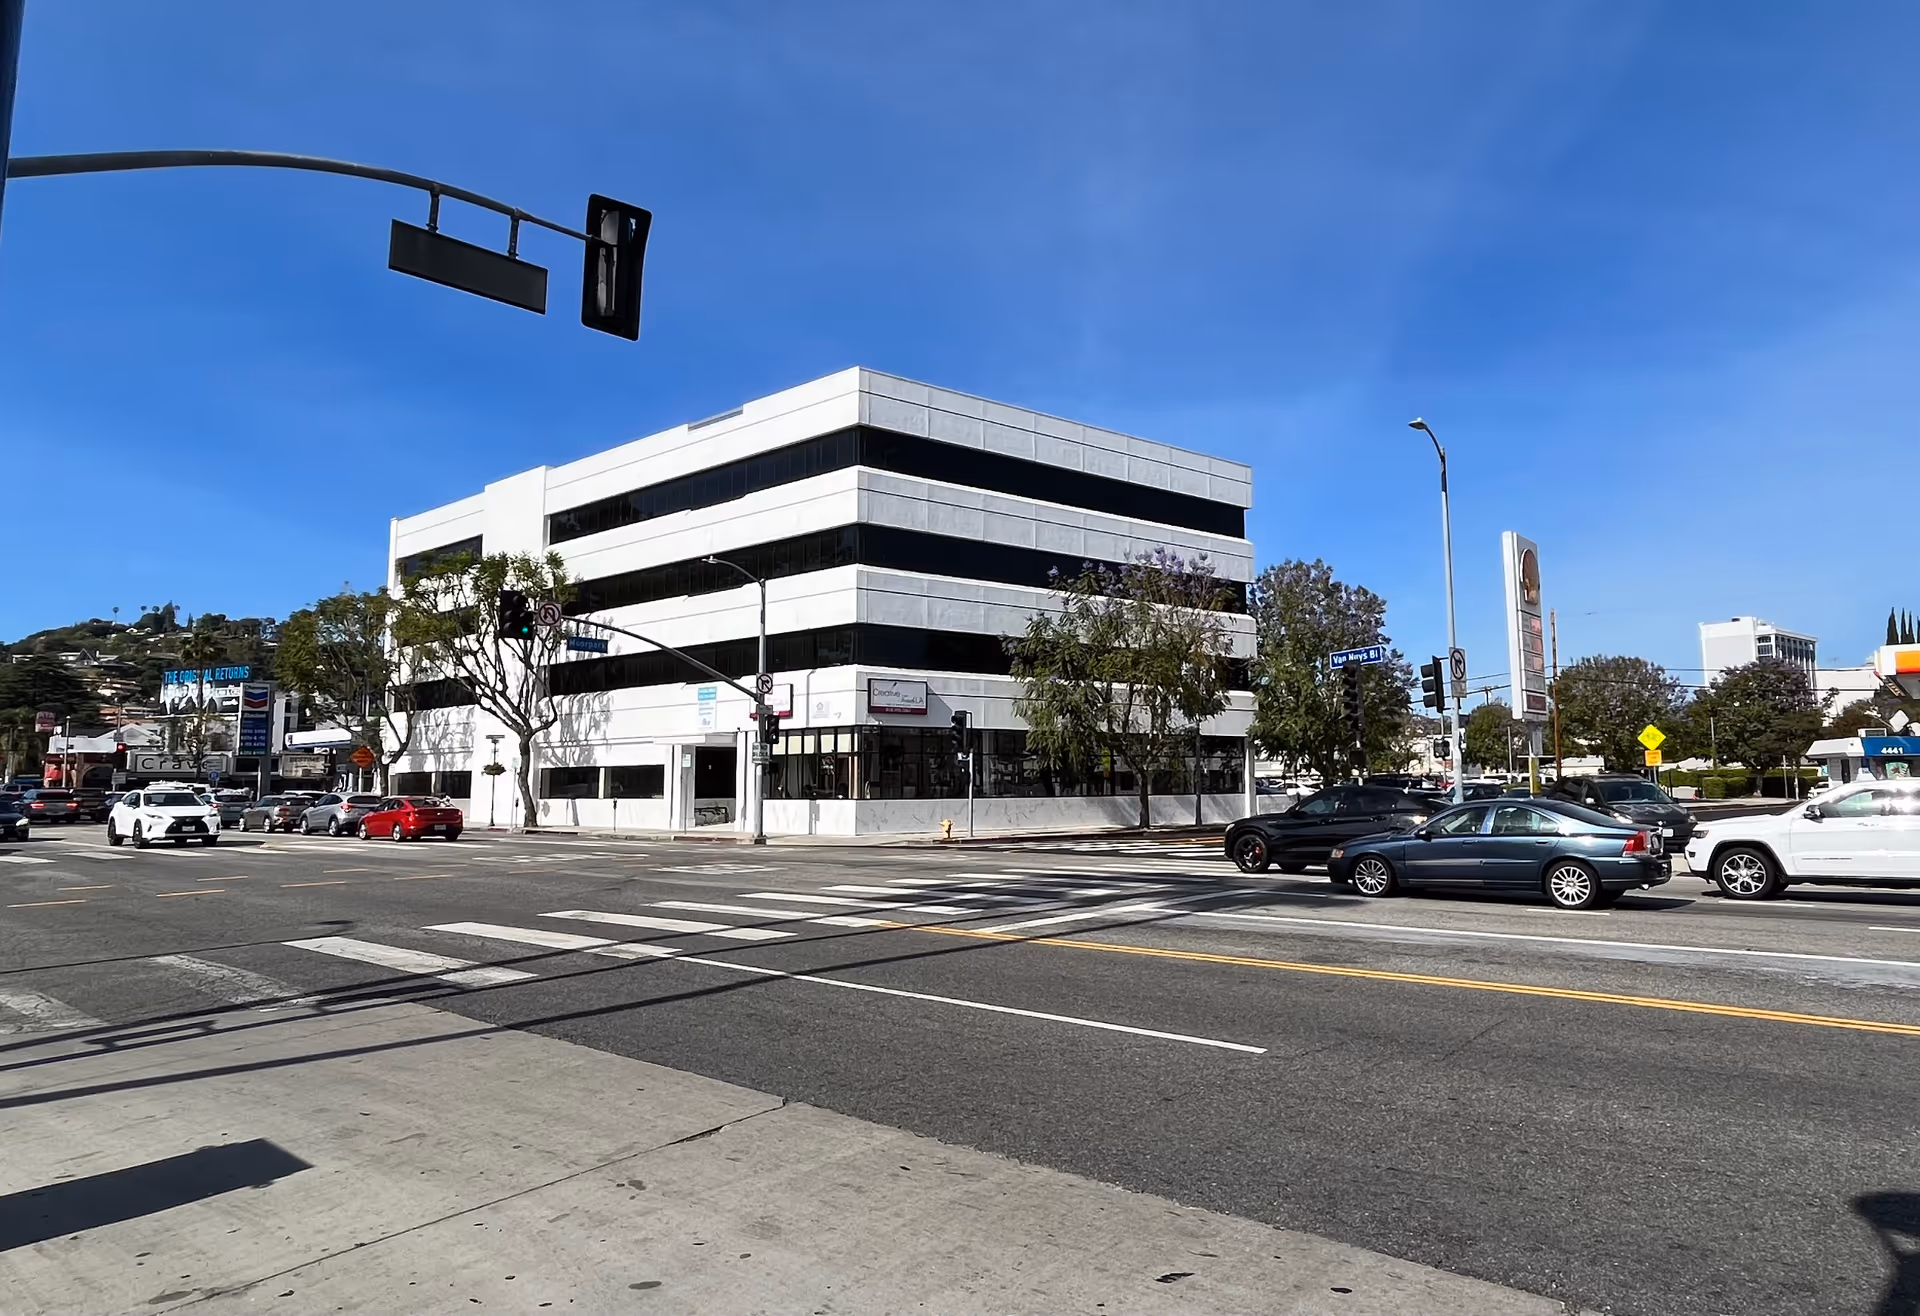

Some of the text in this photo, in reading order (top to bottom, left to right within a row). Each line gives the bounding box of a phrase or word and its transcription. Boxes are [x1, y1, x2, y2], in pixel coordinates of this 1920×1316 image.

[569, 639, 606, 650] Moorpark
[1333, 655, 1347, 664] Van
[1369, 649, 1379, 659] Bl
[164, 665, 250, 684] THE ORIGAL RETURNS
[872, 687, 901, 698] Creative
[1880, 746, 1904, 755] 4441
